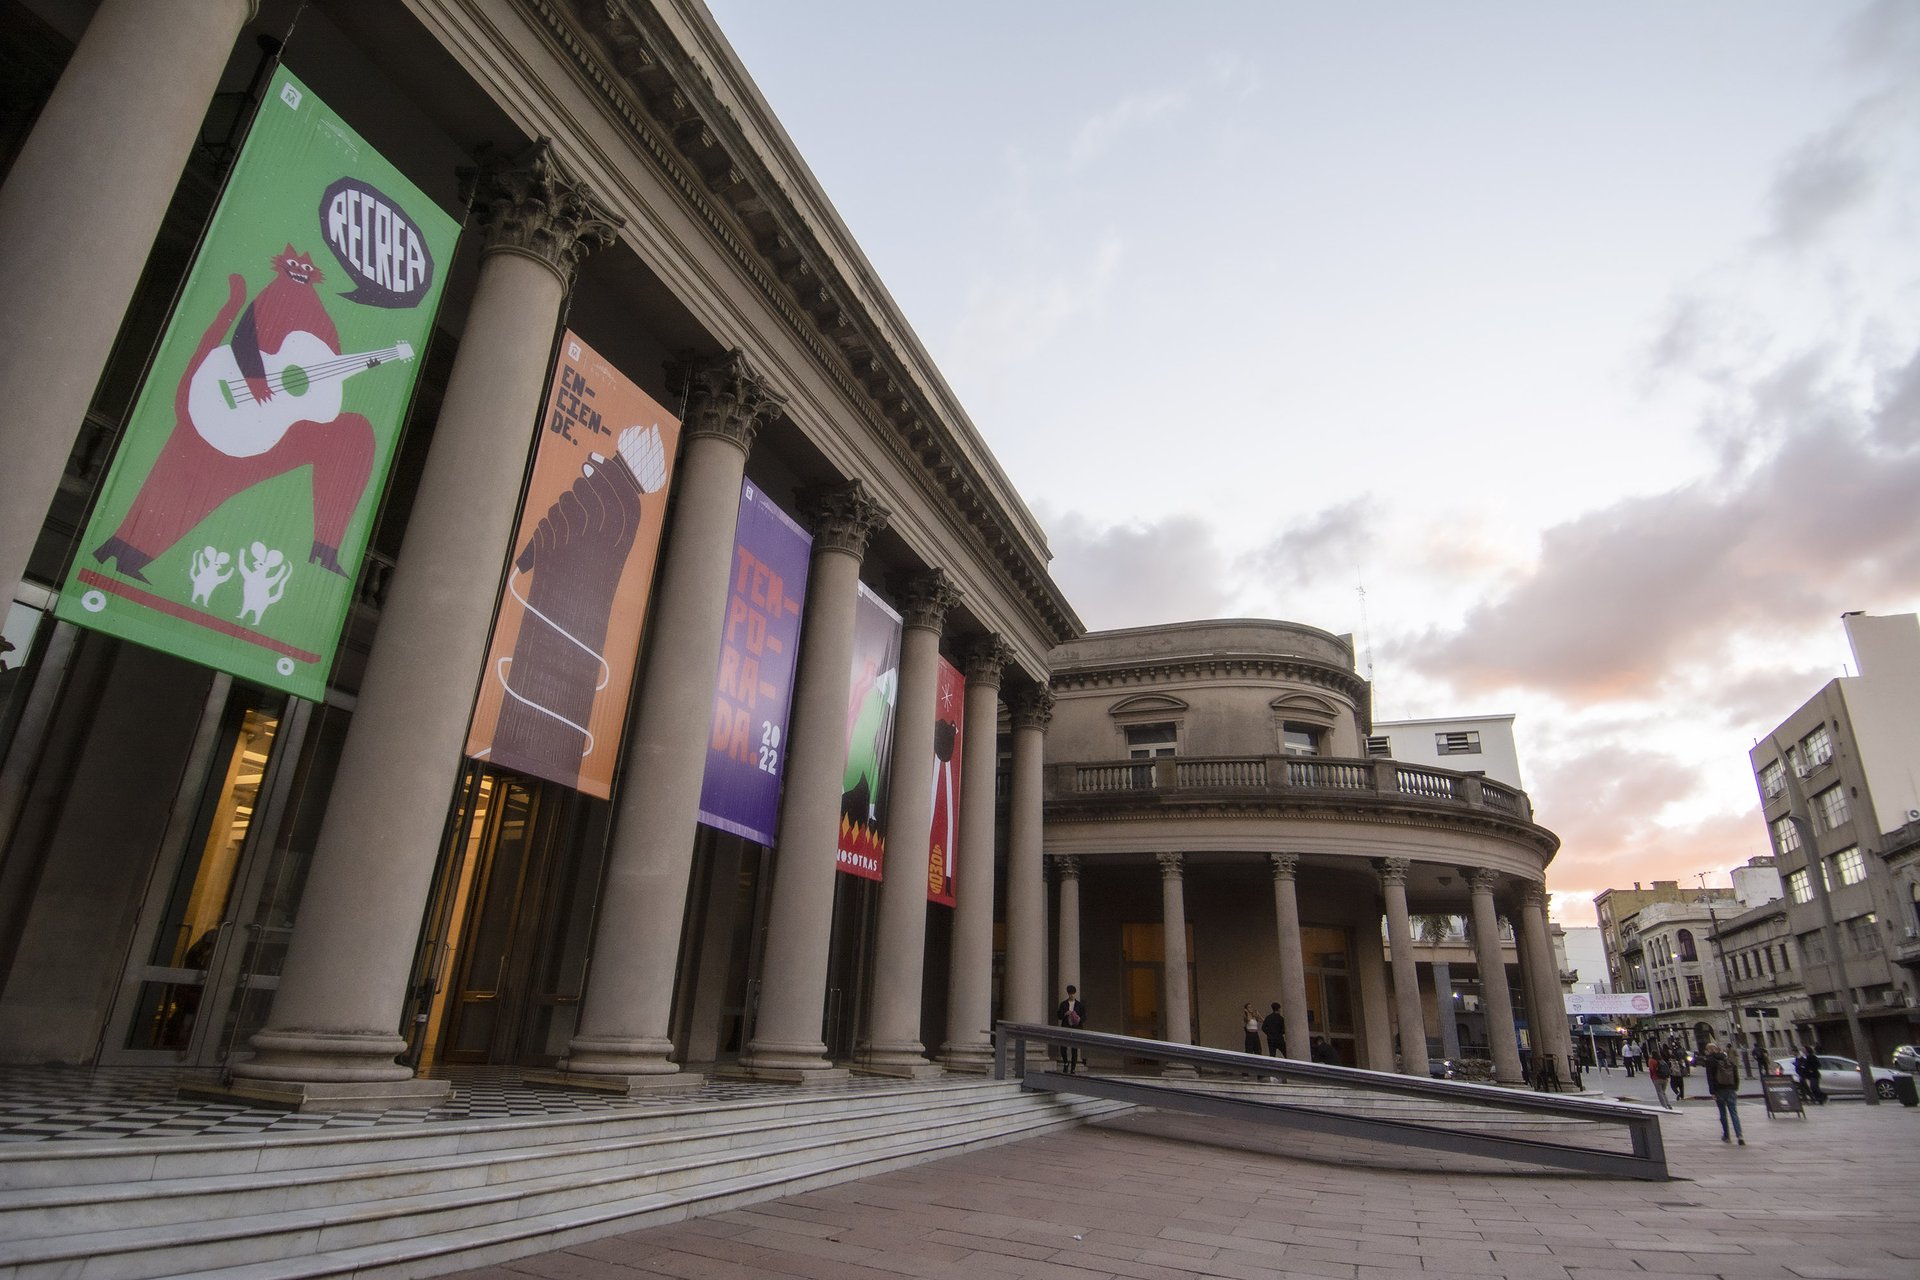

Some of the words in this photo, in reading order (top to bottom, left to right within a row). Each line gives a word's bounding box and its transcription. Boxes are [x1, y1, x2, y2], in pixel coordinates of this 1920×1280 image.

[328, 189, 426, 293] RECREA
[561, 364, 596, 398] EN-
[551, 409, 578, 446] DE.
[556, 386, 612, 437] CIEN-
[737, 543, 800, 619] TEM-
[726, 593, 783, 657] PO-
[719, 643, 776, 709] RA-
[712, 696, 757, 765] DA.
[762, 720, 780, 749] 20
[759, 745, 777, 775] 22
